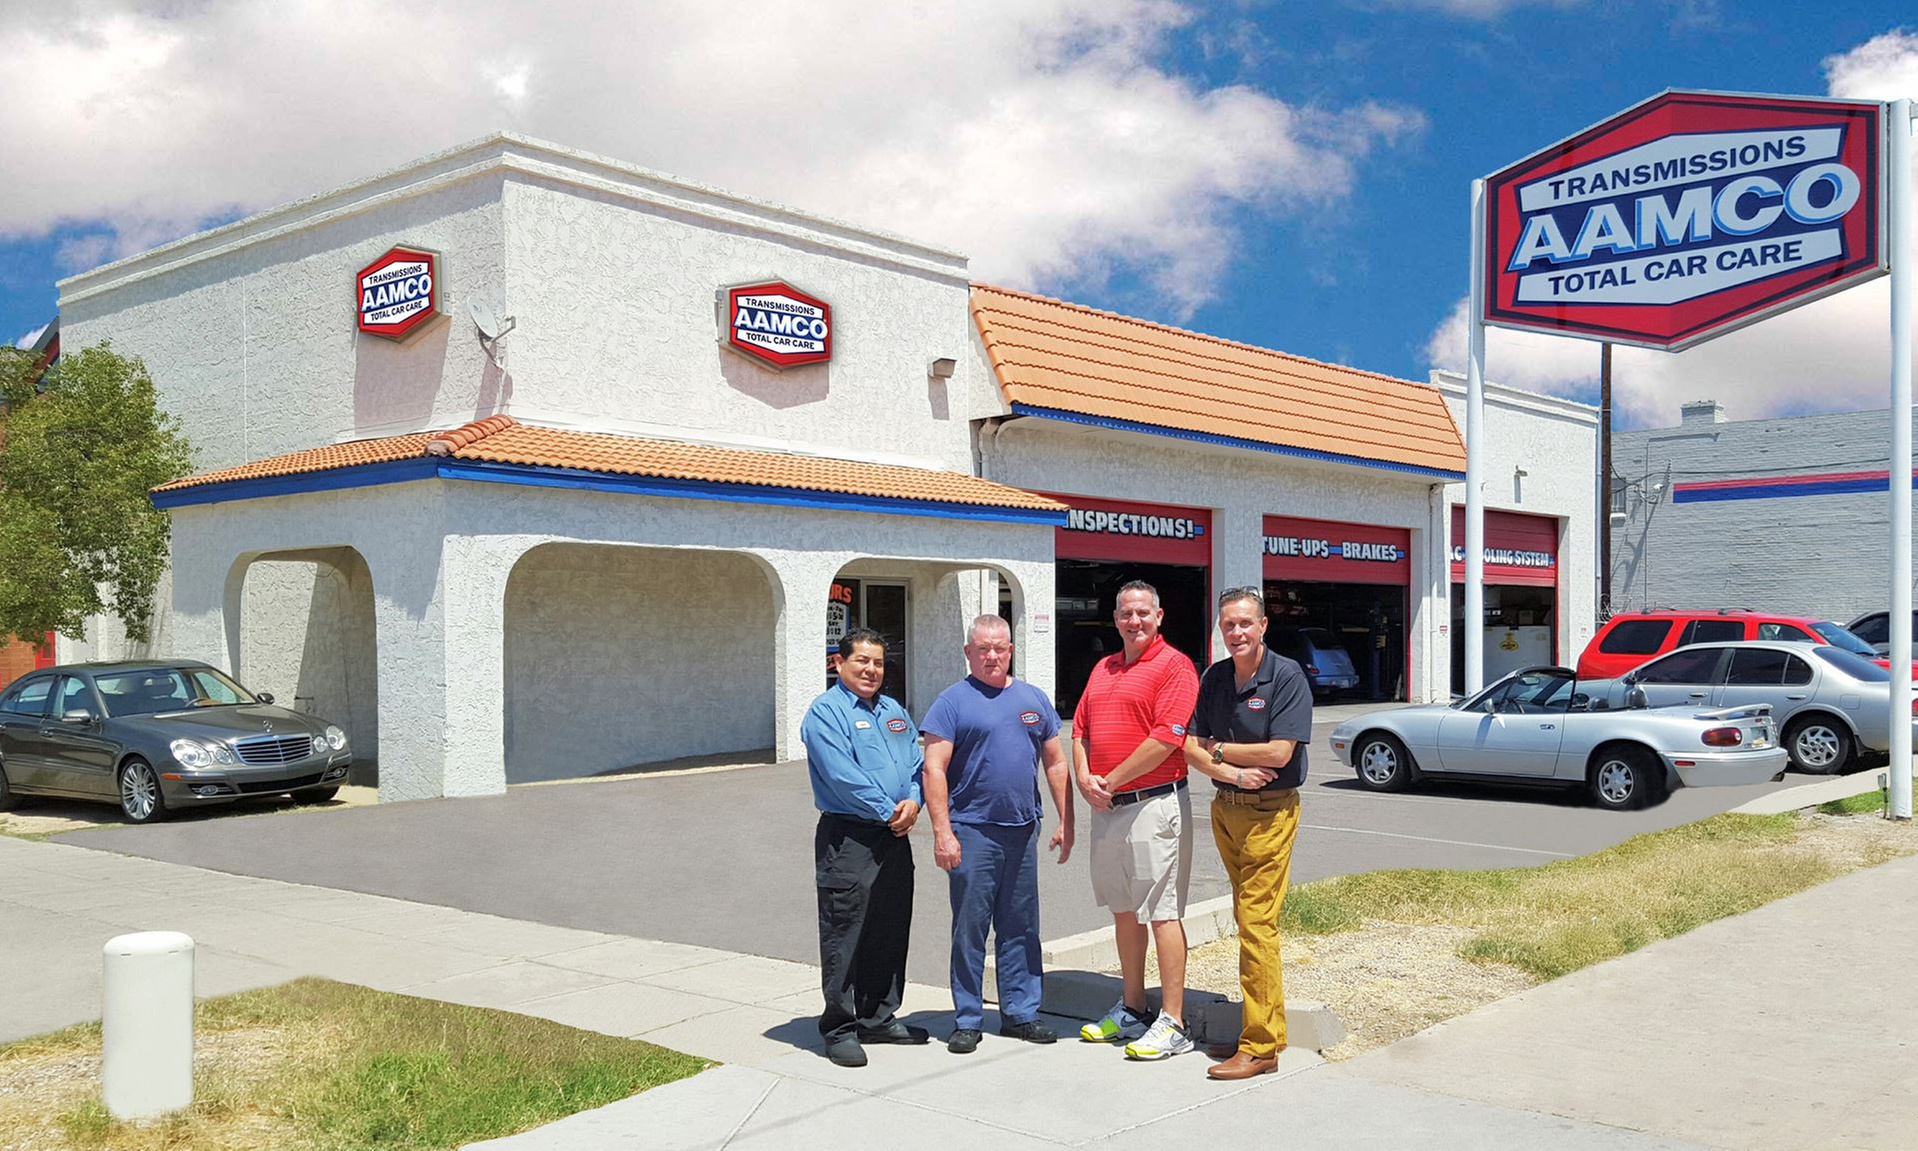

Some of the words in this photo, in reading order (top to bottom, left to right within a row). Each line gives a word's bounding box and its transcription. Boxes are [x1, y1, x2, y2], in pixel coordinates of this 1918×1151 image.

[1548, 135, 1807, 200] TRANSMISSIONS
[1508, 163, 1861, 271] AAMCO
[368, 264, 422, 285] TRANSMISSIONS
[1548, 267, 1636, 296] TOTAL
[1644, 255, 1707, 281] CAR
[1716, 241, 1803, 271] CARE
[361, 274, 432, 312] AAMCO
[371, 311, 390, 321] TOTAL
[391, 305, 405, 316] CAR
[405, 300, 423, 312] CARE
[745, 297, 815, 316] TRANSMISSIONS
[734, 308, 829, 340] AAMCO
[746, 332, 772, 344] TOTAL
[773, 336, 791, 347] CAR
[792, 340, 815, 350] CARE
[1341, 541, 1398, 562] BRAKES
[1483, 548, 1513, 564] OLING
[1514, 550, 1549, 567] SYSTEM
